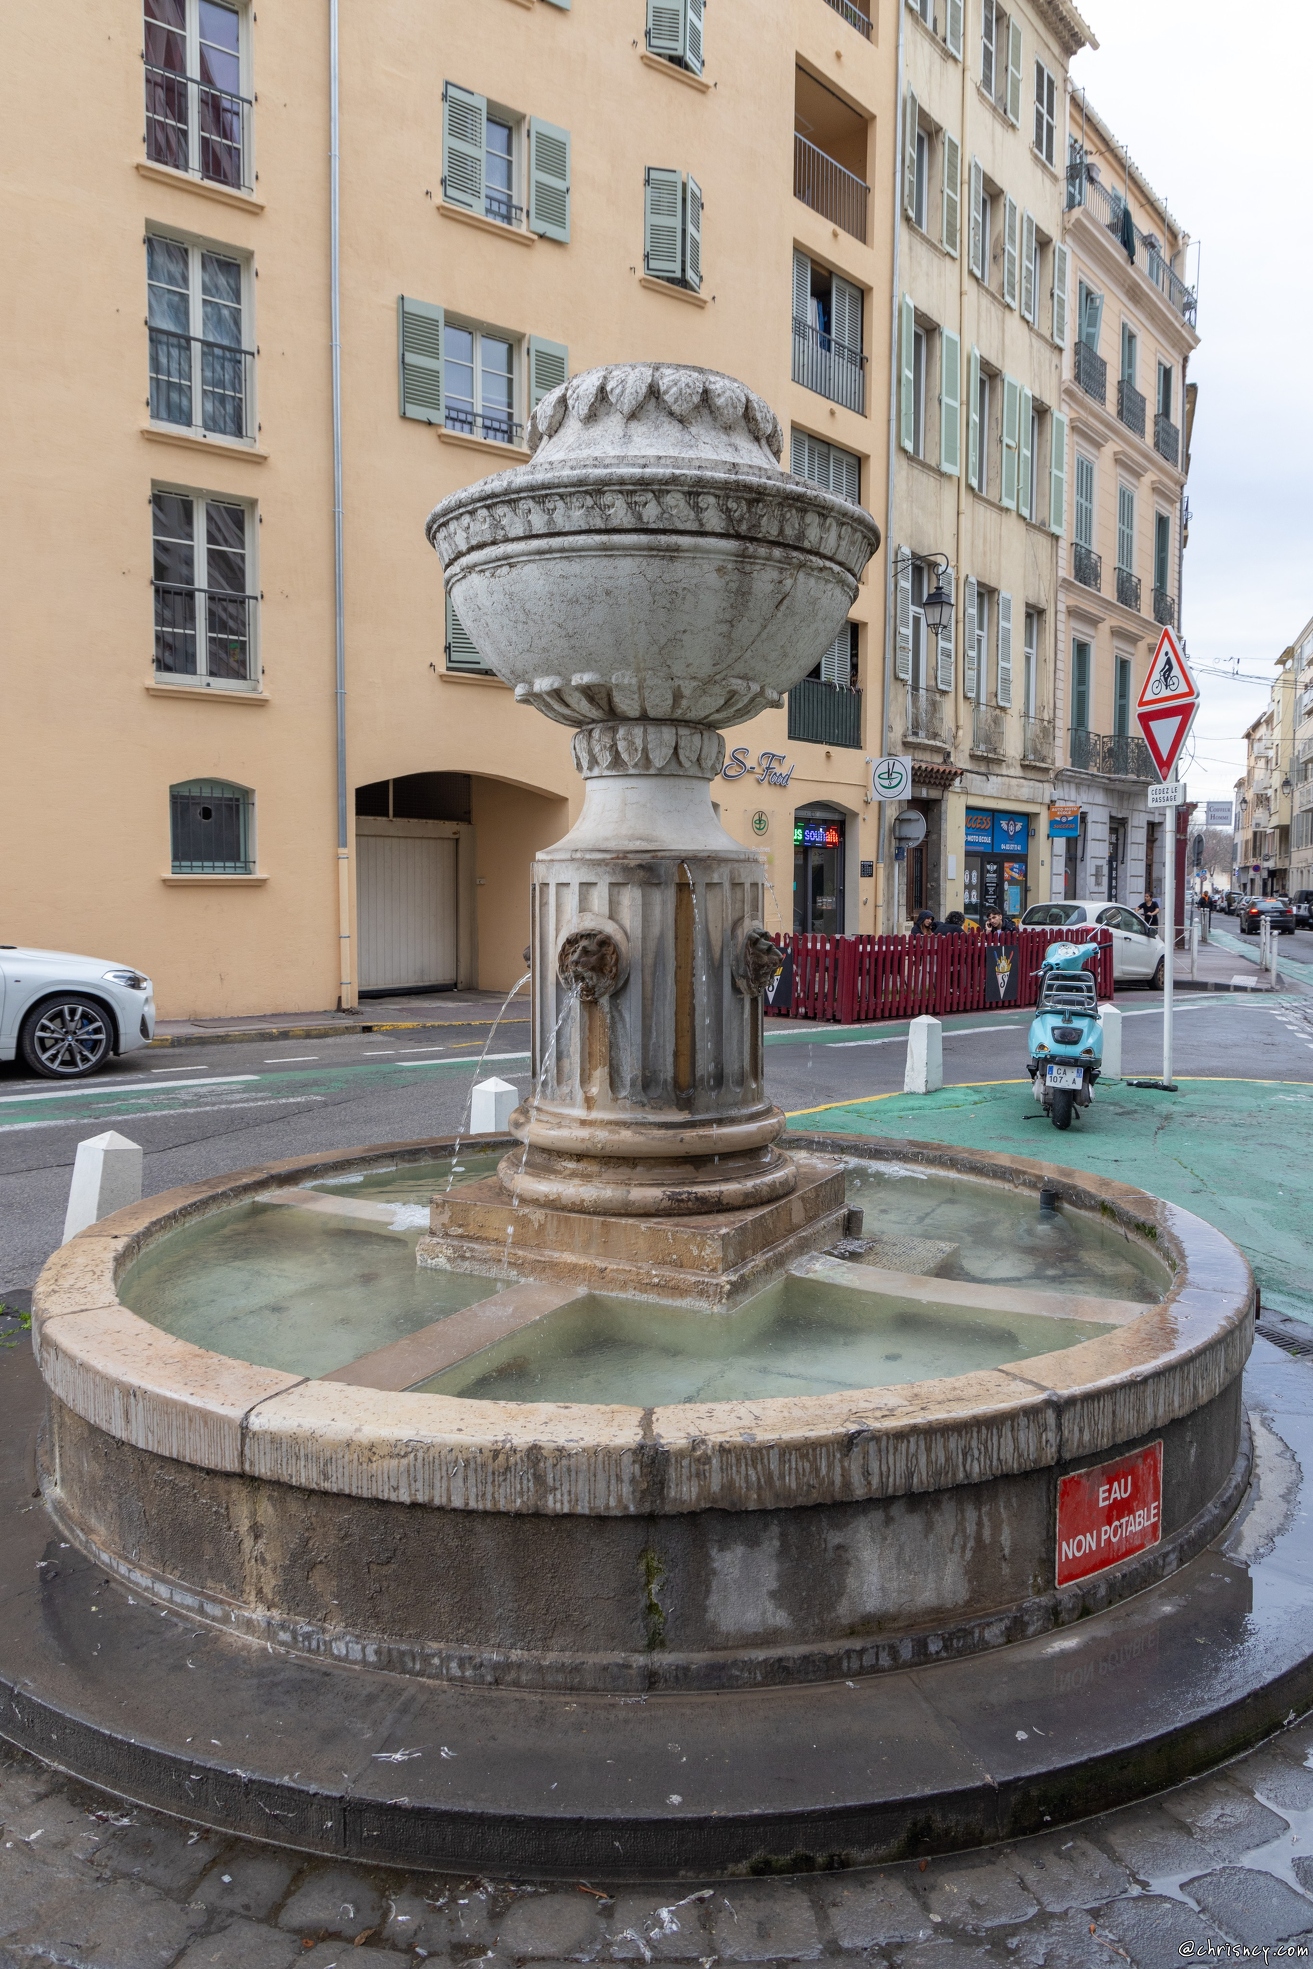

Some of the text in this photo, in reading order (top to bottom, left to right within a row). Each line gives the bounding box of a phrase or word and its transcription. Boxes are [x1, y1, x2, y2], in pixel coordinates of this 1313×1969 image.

[1151, 786, 1178, 796] CÉDEZ LE
[1151, 795, 1177, 803] PASSAGE
[1098, 1475, 1132, 1508] EAU
[1061, 1501, 1159, 1562] NON POTABLE
